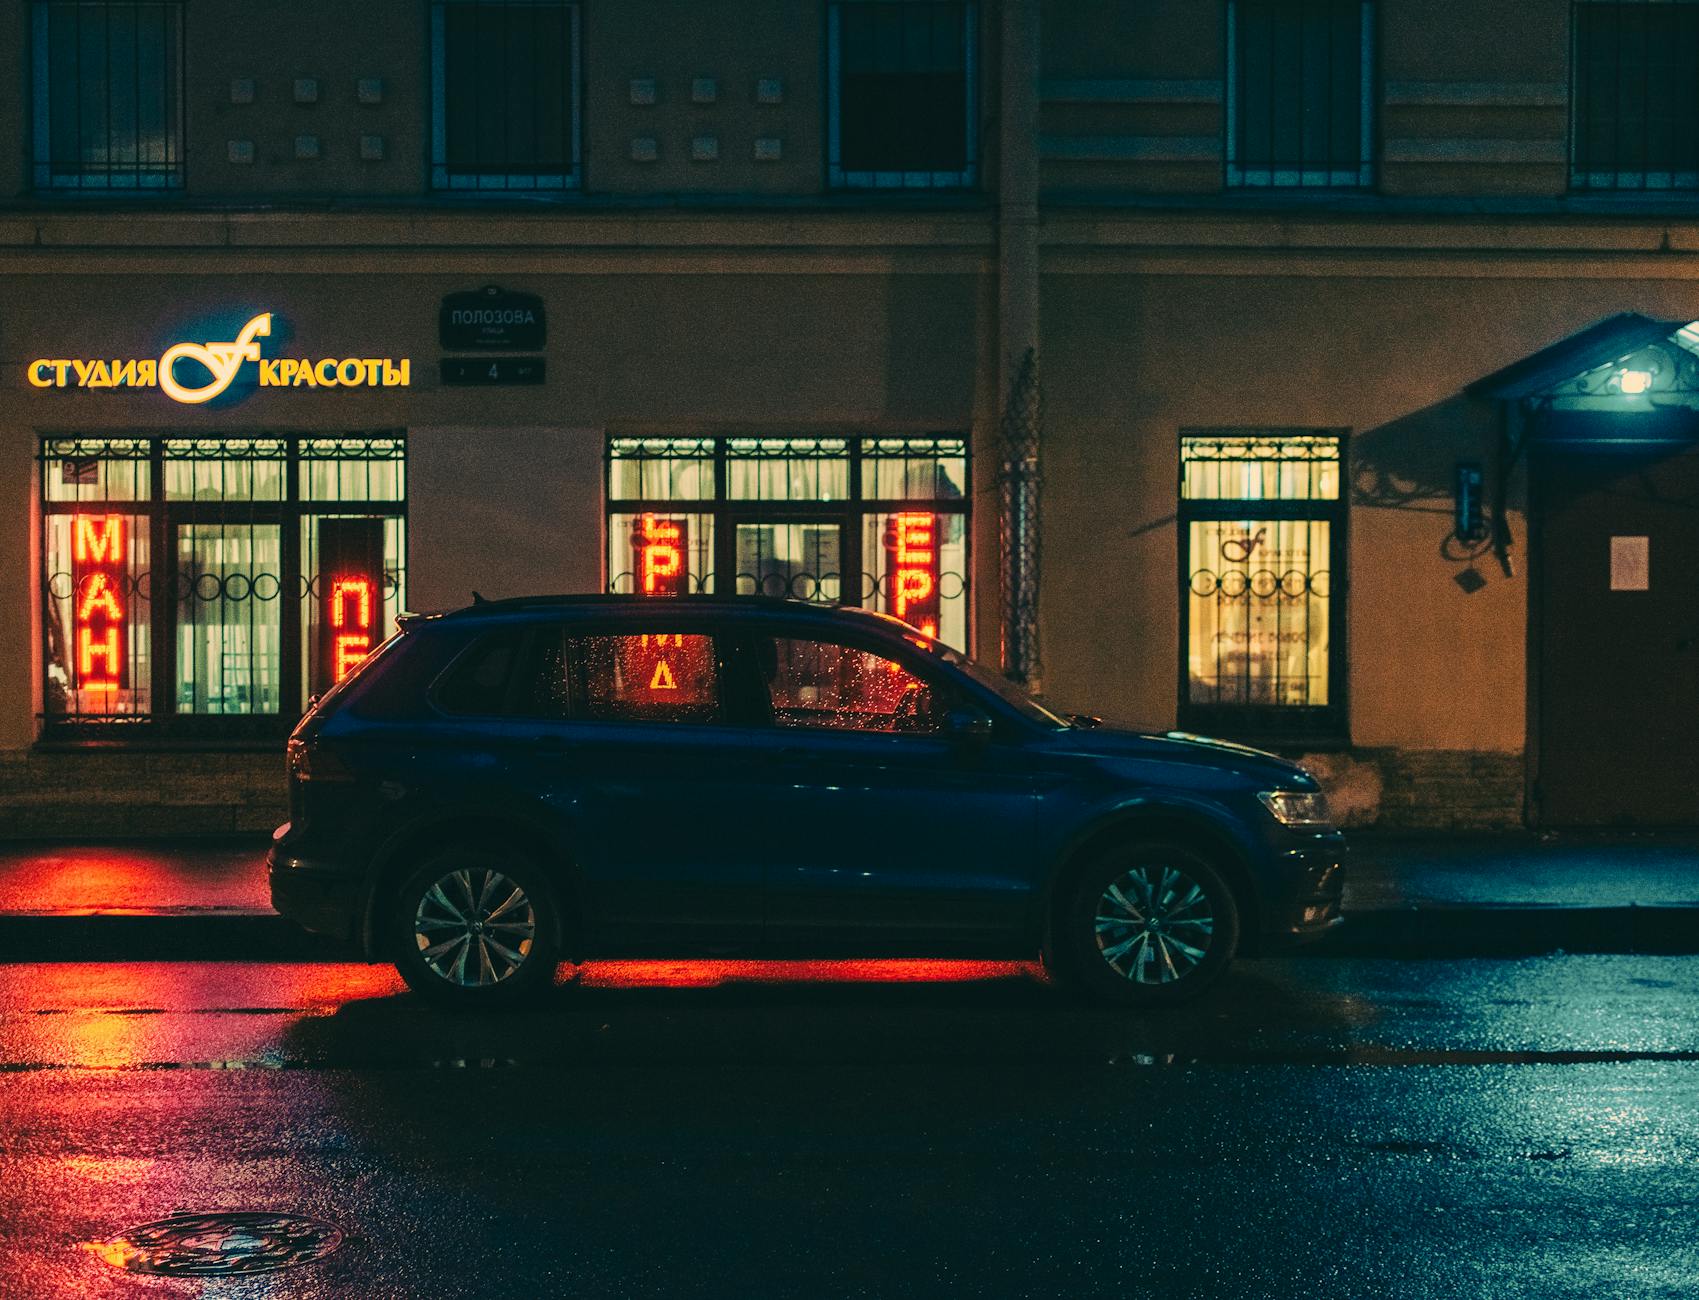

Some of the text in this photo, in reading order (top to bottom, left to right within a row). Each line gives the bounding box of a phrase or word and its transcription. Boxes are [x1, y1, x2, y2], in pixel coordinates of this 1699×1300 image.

[452, 309, 535, 325] ПОЛОЗОВА
[28, 358, 157, 388] СТУДИЯ
[259, 357, 411, 388] КРАСОТЫ
[488, 363, 499, 379] 4
